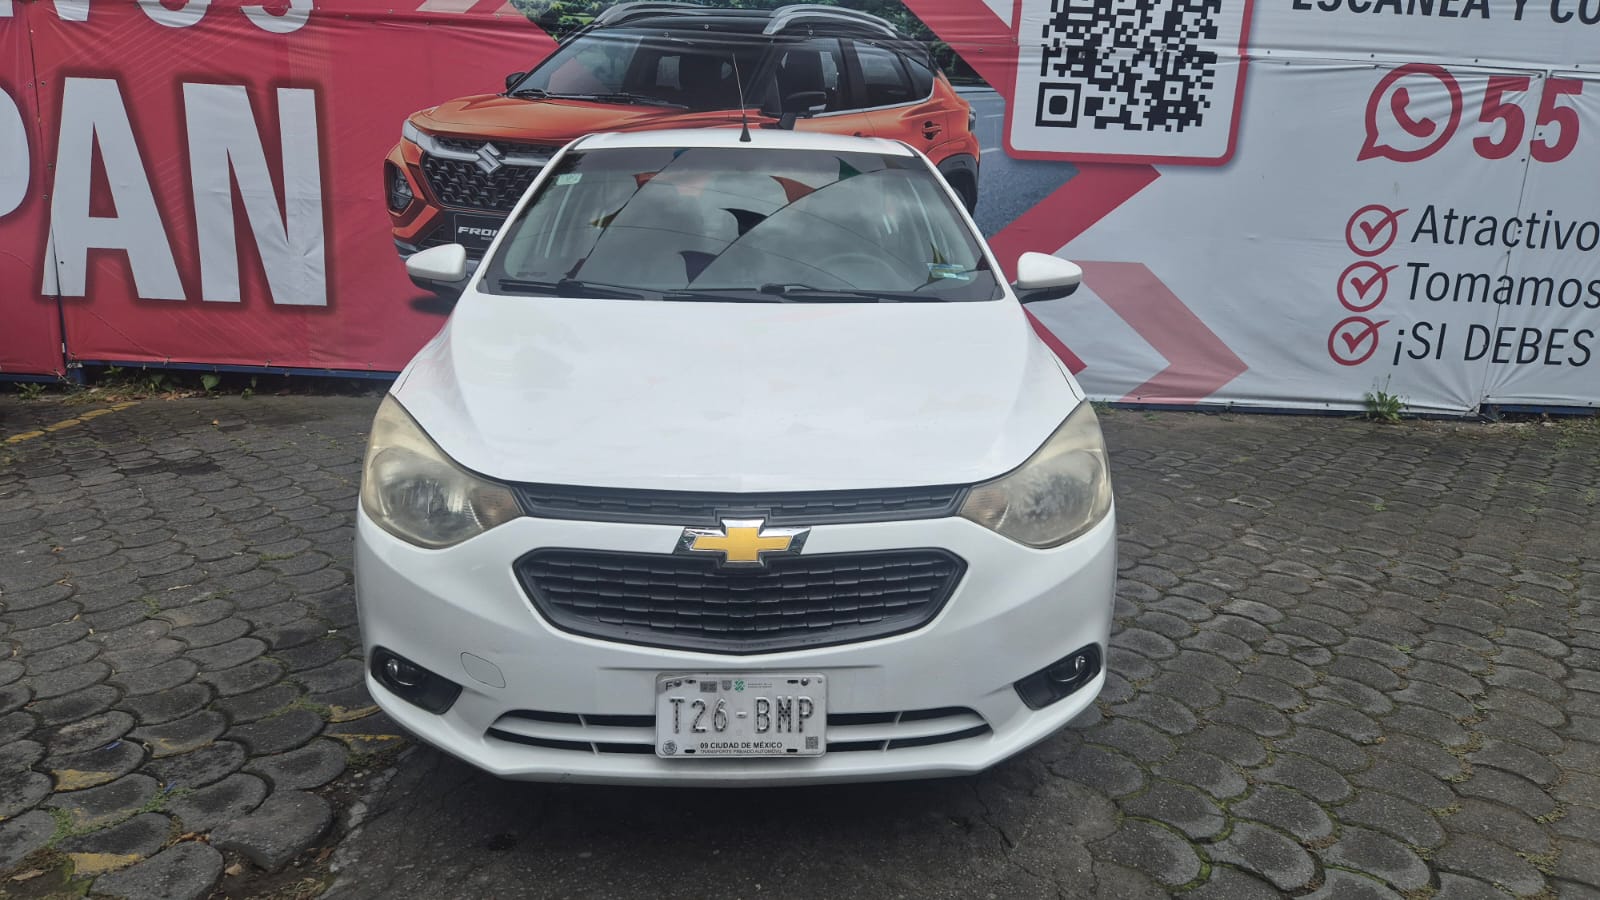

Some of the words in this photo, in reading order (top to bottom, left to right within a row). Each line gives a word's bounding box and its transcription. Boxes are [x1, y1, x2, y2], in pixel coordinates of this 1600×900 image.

[1472, 75, 1584, 163] 55
[0, 76, 328, 307] AN
[1410, 204, 1600, 251] Atractivo
[1406, 262, 1600, 309] Tomamos
[1463, 324, 1595, 367] DEBES
[753, 740, 783, 749] MÉXICO
